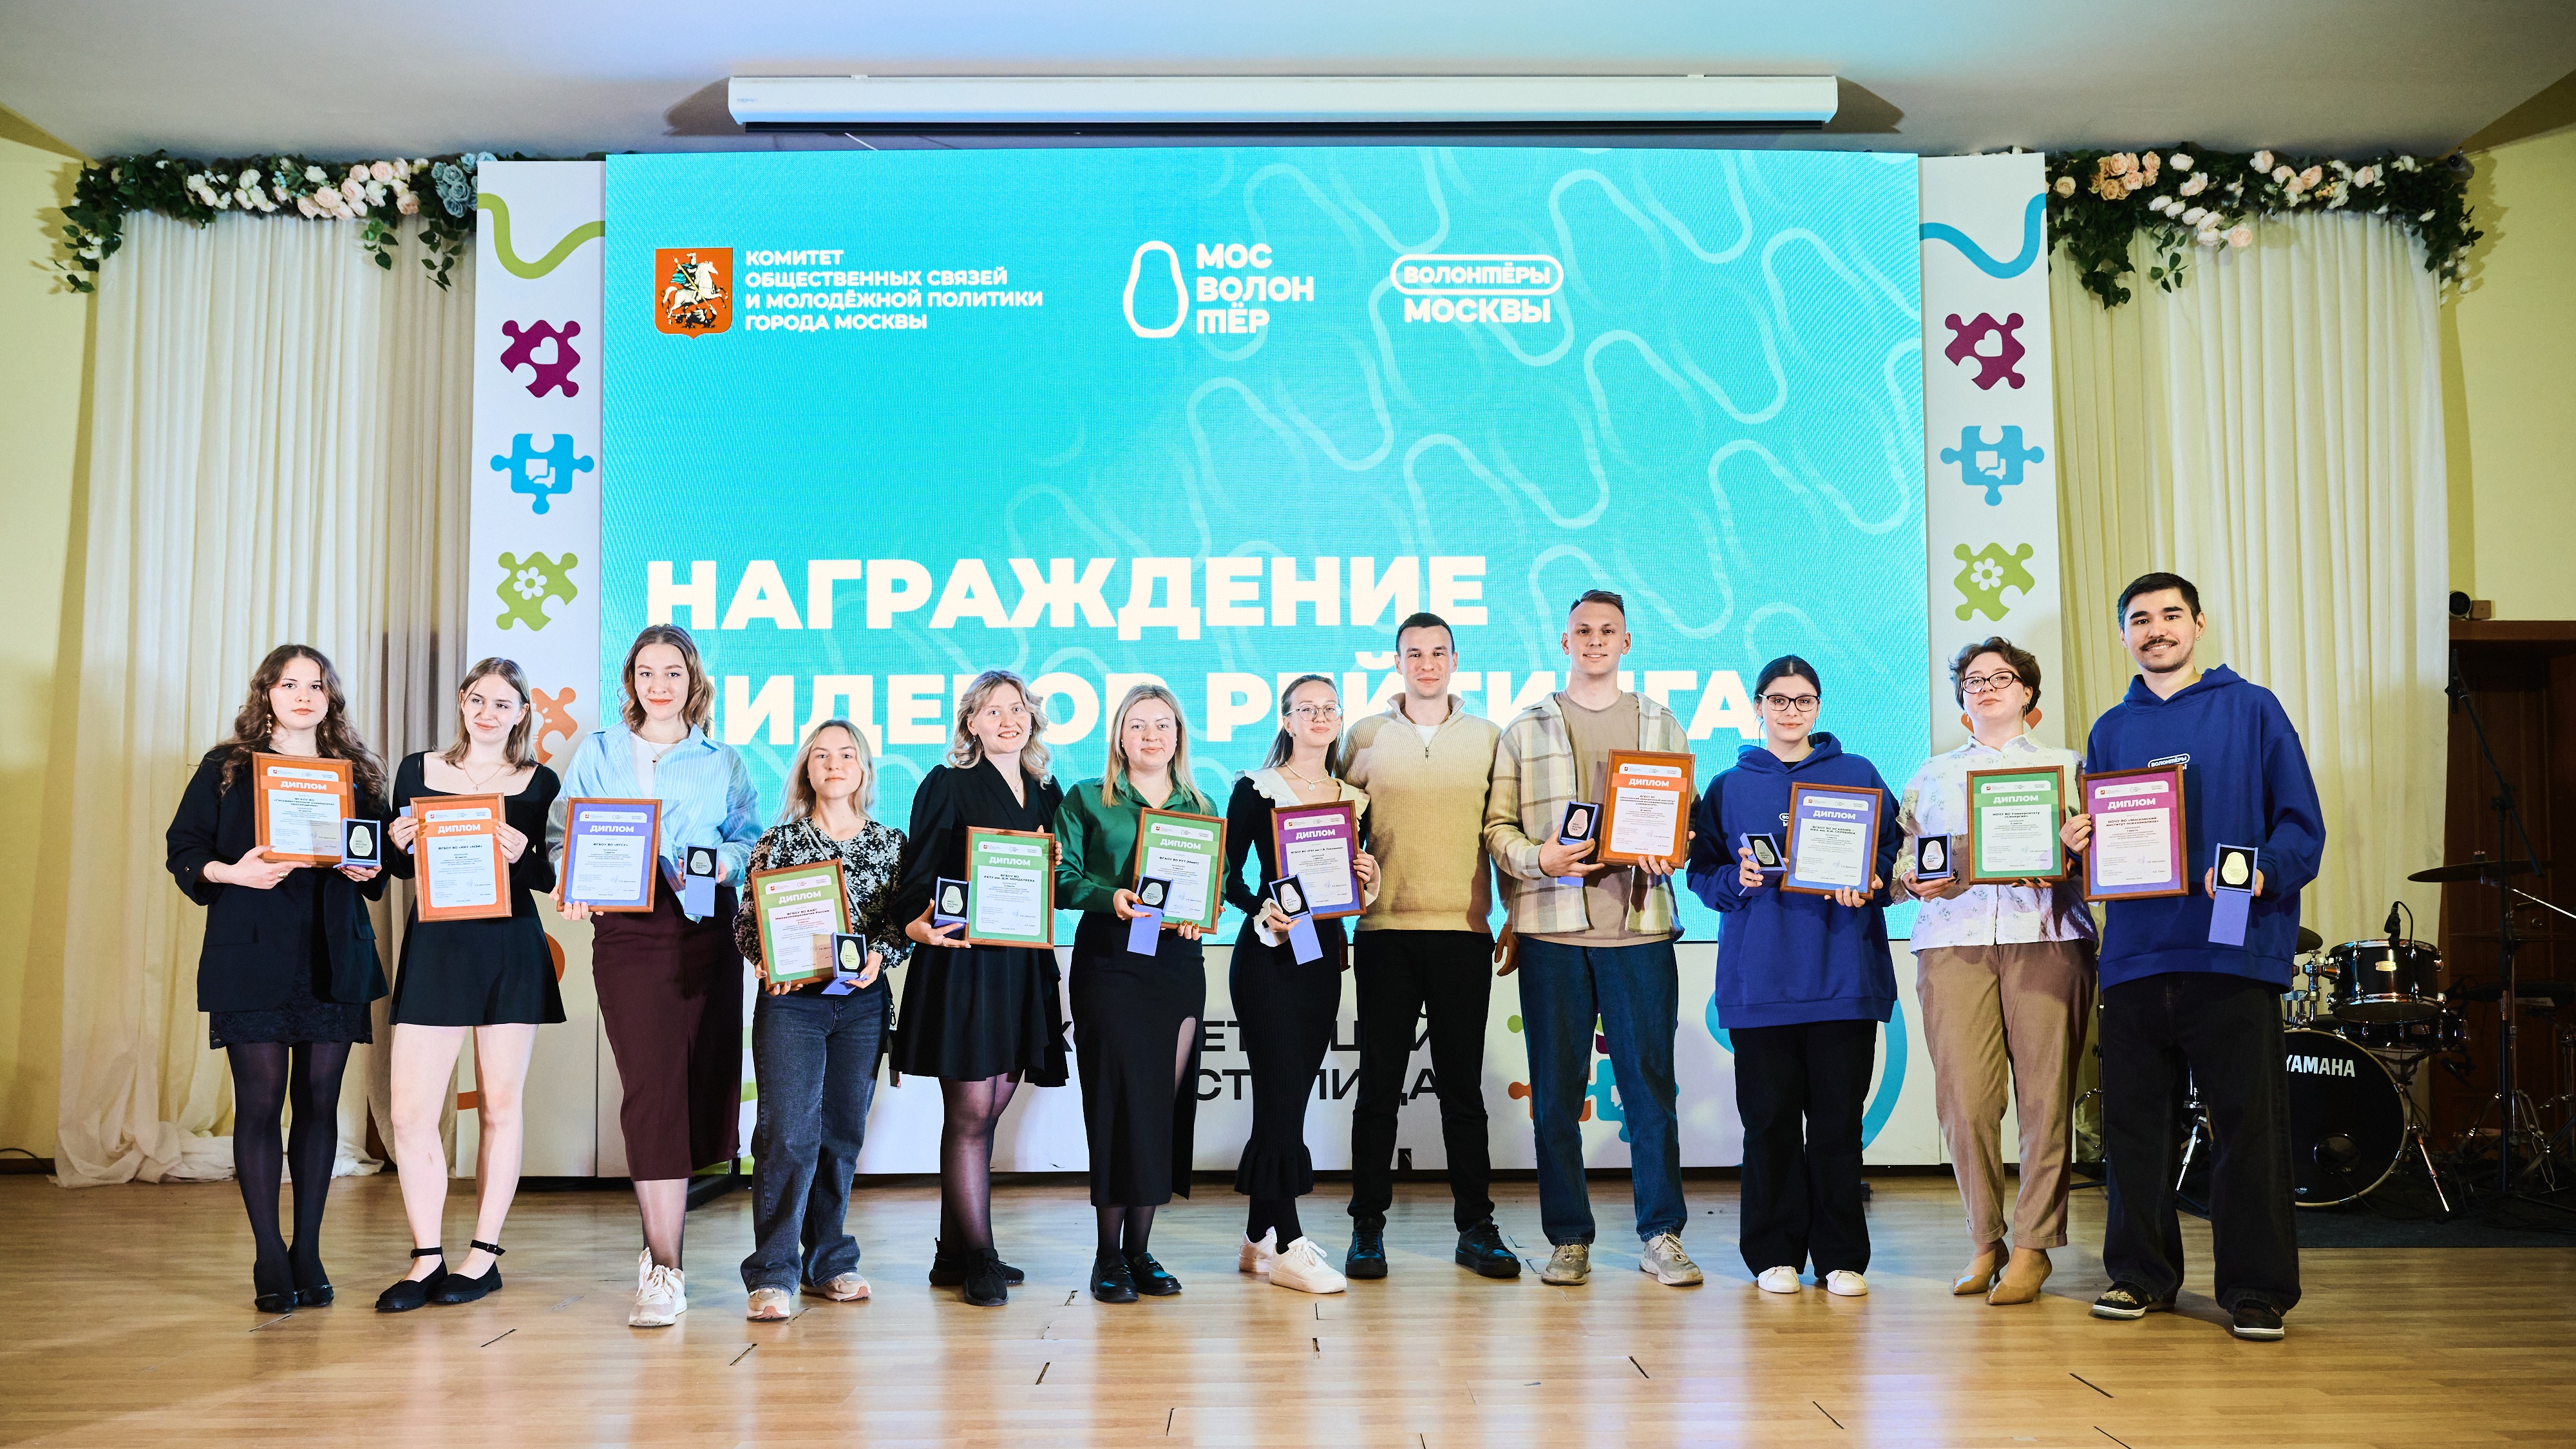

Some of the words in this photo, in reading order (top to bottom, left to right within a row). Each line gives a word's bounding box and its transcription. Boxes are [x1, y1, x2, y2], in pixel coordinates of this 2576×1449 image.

[745, 250, 844, 266] КОМИТЕТ
[1196, 243, 1272, 269] МОС
[745, 270, 922, 290] ОБЩЕСТВЕННЫХ
[927, 266, 1008, 286] СВЯЗЕЙ
[1403, 261, 1549, 284] ВОЛОНТЁРЫ
[1196, 276, 1314, 301] ВОЛОН
[745, 294, 761, 309] И
[766, 289, 922, 310] МОЛОДЁЖНОЙ
[927, 291, 1043, 308] ПОЛИТИКИ
[1404, 298, 1551, 323] МОСКВЫ
[745, 314, 829, 332] ГОРОДА
[835, 314, 927, 330] МОСКВЫ
[647, 556, 1488, 641] НАГРАЖДЕНИЕ
[281, 781, 327, 790] ДИПЛОМ
[1628, 778, 1669, 787] ДИПЛОМ
[1993, 795, 2039, 804] ДИПЛОМ
[2108, 798, 2155, 810] ДИПЛОМ
[1813, 810, 1855, 820] ДИПЛОМ
[438, 824, 480, 834] ДИПЛОМ
[1296, 829, 1336, 840] ДИПЛОМ
[1160, 838, 1201, 850] ДИПЛОМ
[989, 857, 1030, 866] ДИПЛОМ
[779, 891, 821, 904] ДИПЛОМ
[2286, 1055, 2356, 1077] YAMAHA
